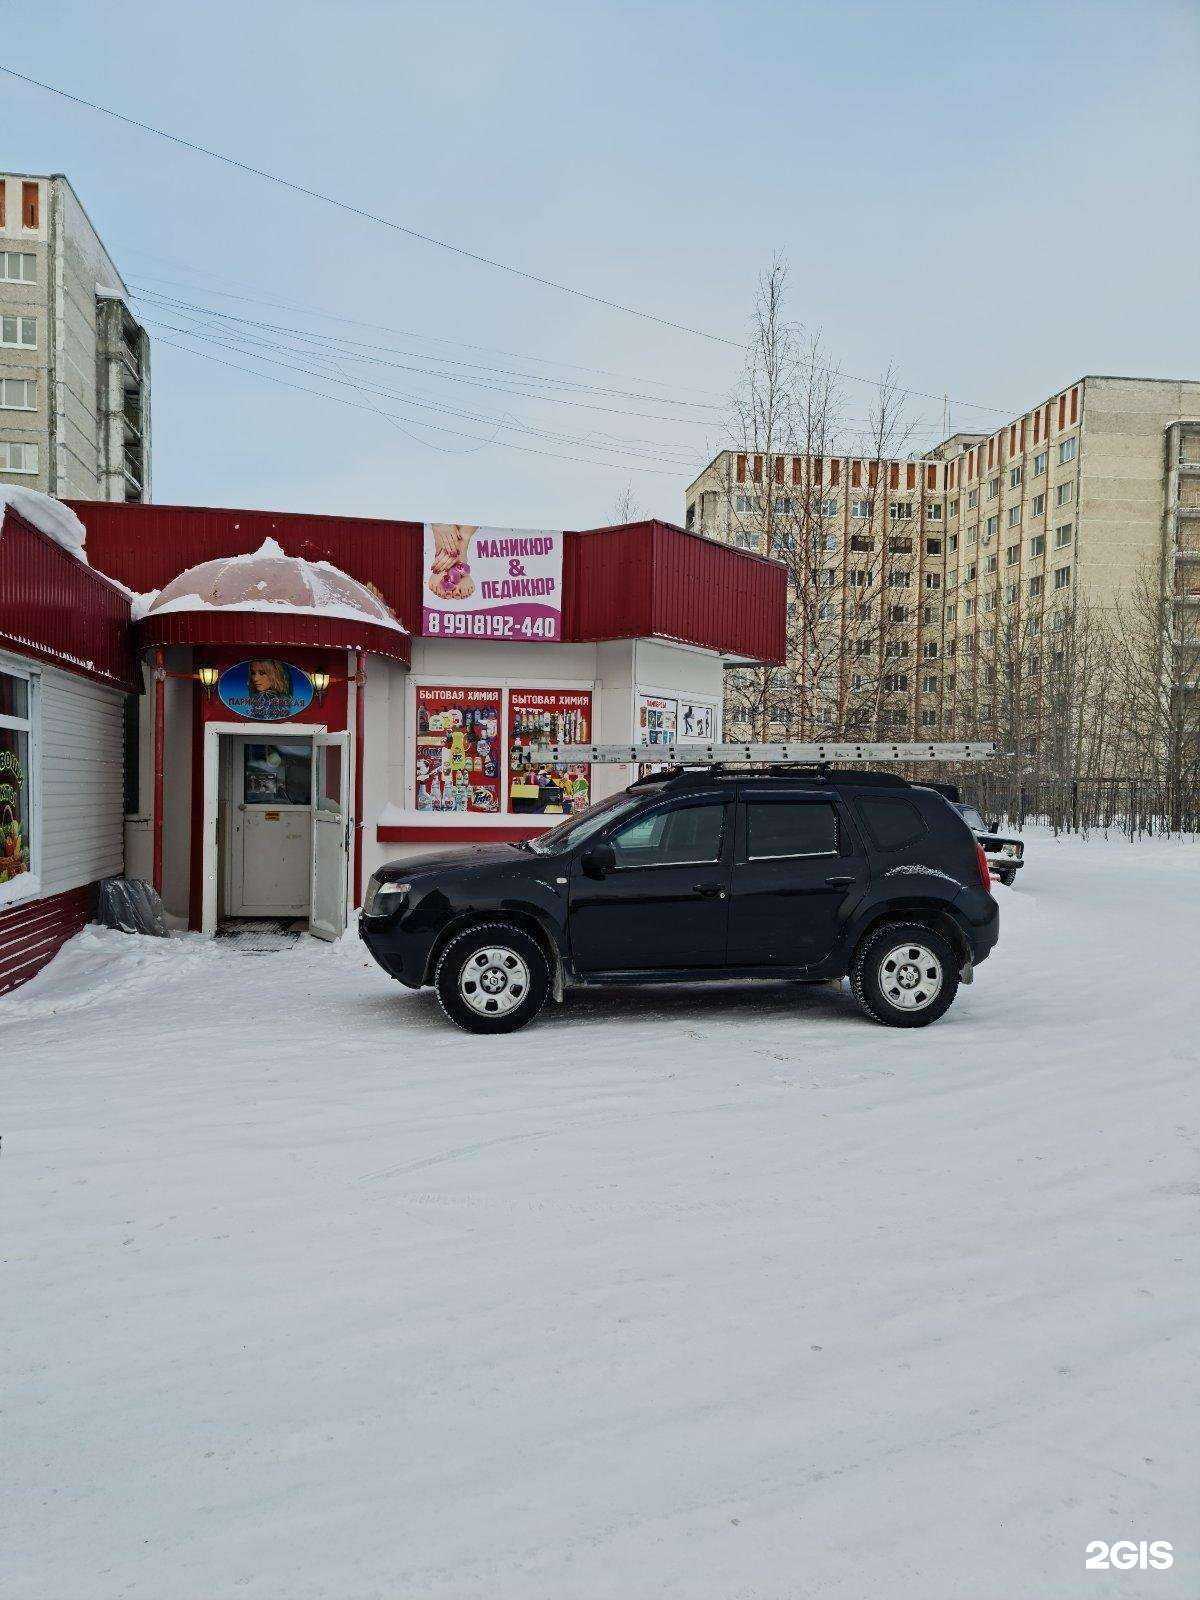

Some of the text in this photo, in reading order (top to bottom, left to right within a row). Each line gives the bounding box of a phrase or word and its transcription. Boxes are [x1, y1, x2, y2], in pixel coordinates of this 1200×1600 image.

[477, 537, 554, 558] МАНИКЮР
[508, 559, 526, 577] &
[481, 578, 555, 599] ПЕДИКЮР
[428, 612, 555, 637] 8 9918192-440
[419, 690, 499, 701] БЫТОВАЯ ХИМИЯ
[512, 694, 589, 706] БЫТОВАЯ ХИМИЯ
